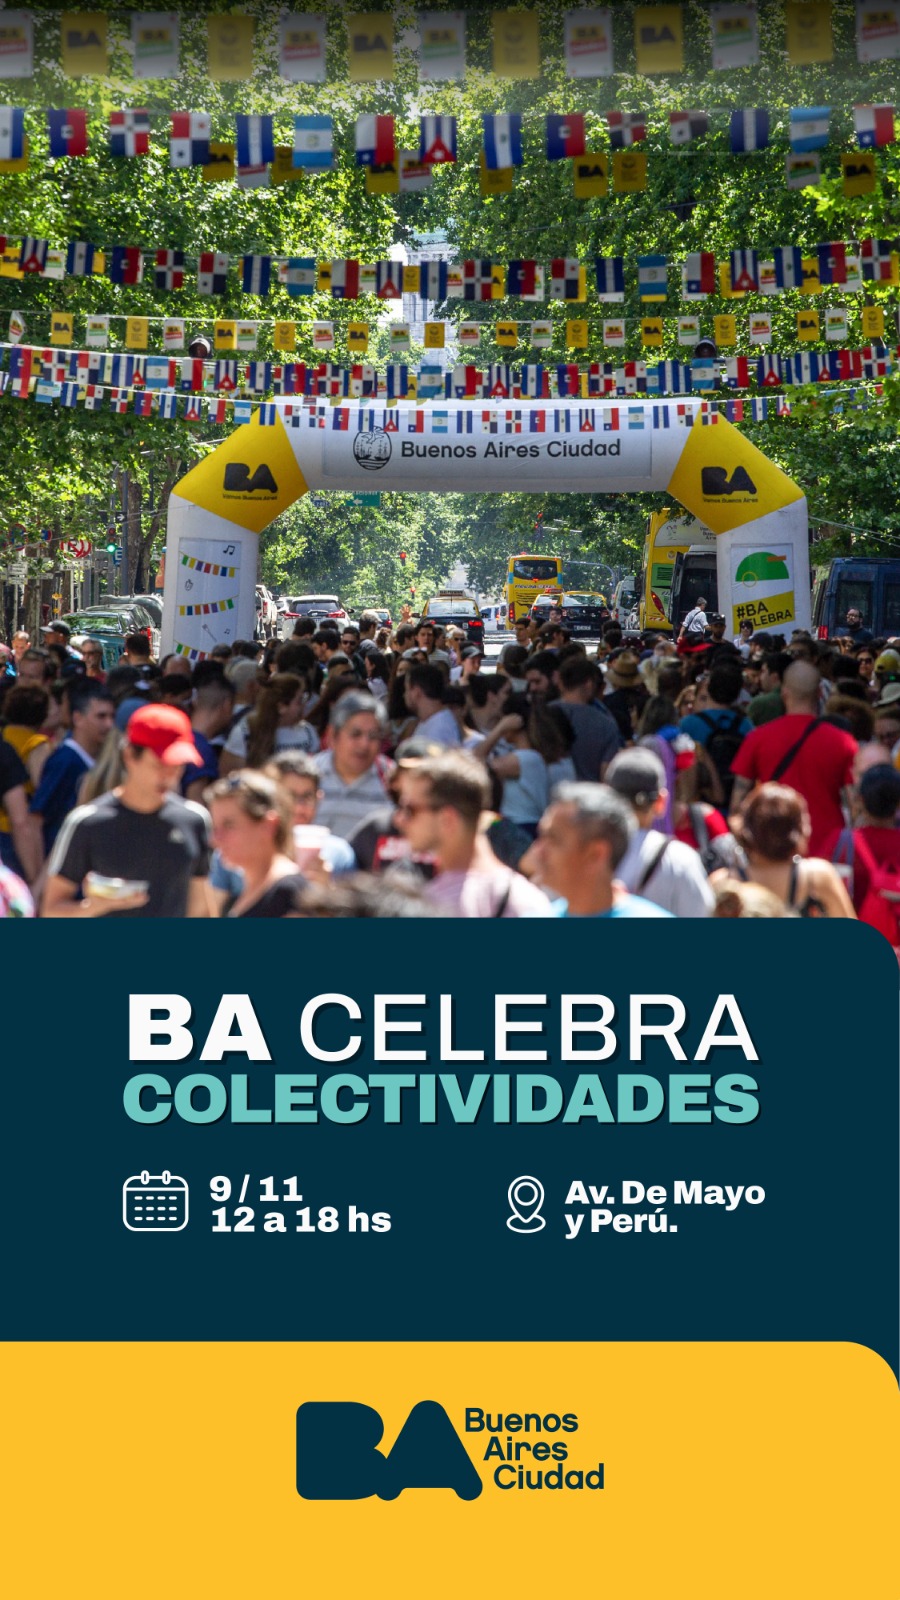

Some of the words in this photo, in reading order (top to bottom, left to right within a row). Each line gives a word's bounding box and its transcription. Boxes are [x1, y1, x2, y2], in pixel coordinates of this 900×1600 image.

[67, 29, 101, 48] BA
[353, 33, 387, 52] BA
[641, 26, 675, 44] BA
[578, 165, 604, 178] BA
[846, 164, 871, 177] BA
[54, 322, 70, 332] BA
[644, 326, 660, 334] BA
[800, 320, 816, 329] BA
[217, 329, 233, 337] BA
[350, 331, 366, 339] BA
[401, 441, 477, 458] Buenos
[484, 441, 540, 458] Aires
[547, 438, 621, 457] Ciudad
[223, 463, 278, 493] BA
[701, 466, 757, 495] BA
[737, 601, 768, 619] #BA
